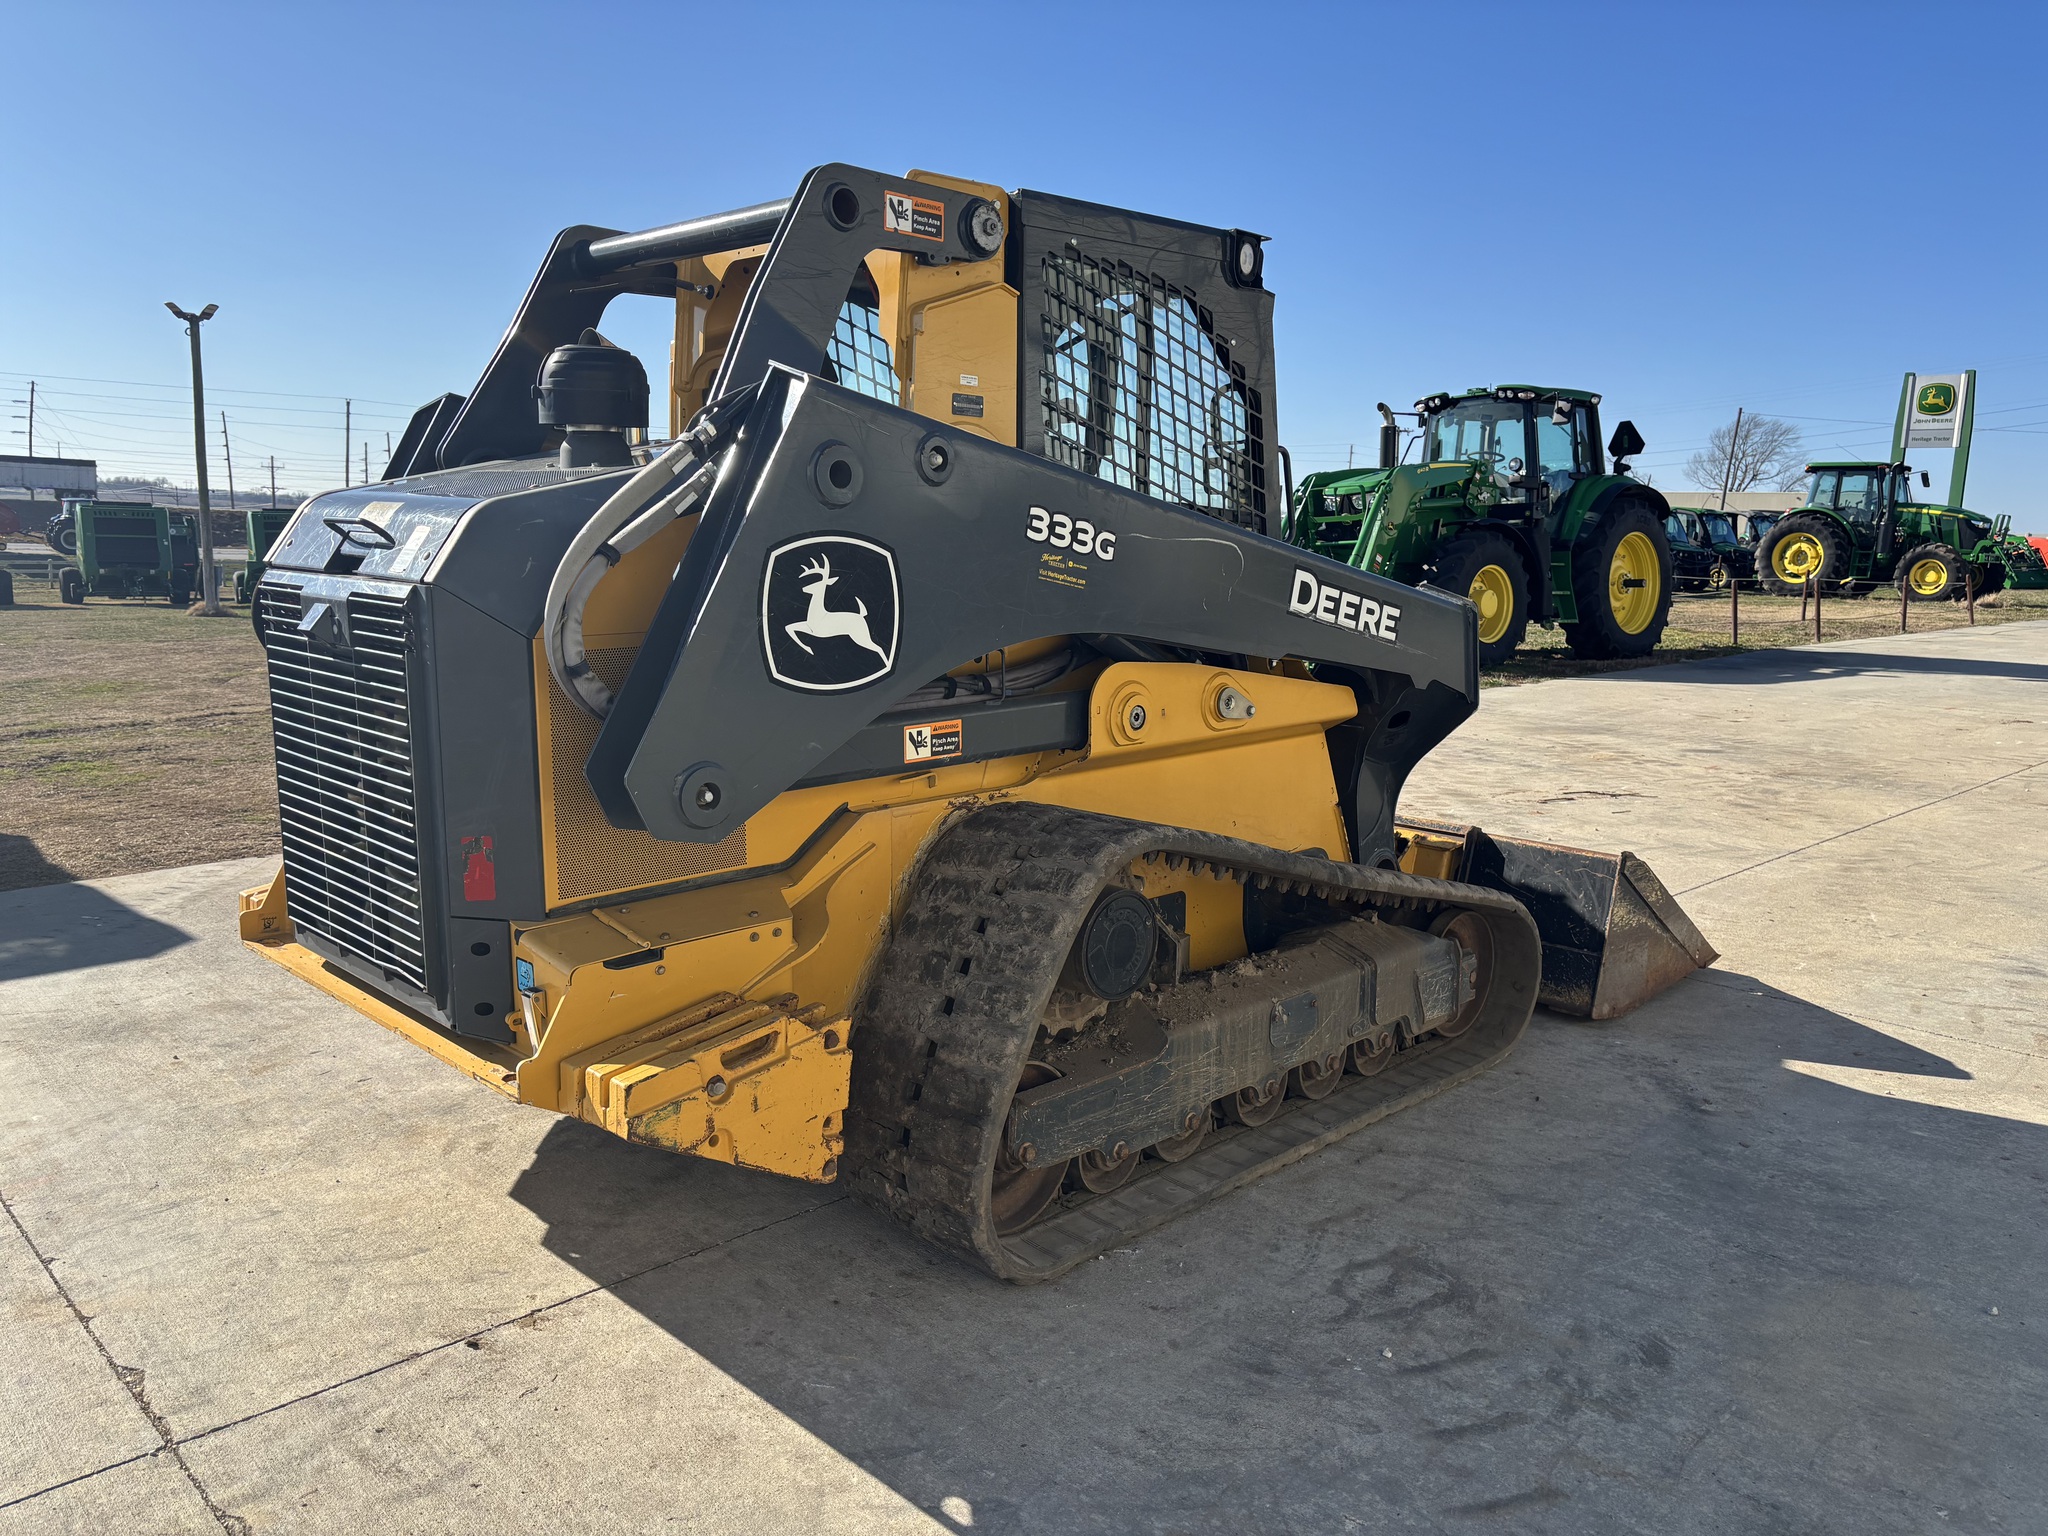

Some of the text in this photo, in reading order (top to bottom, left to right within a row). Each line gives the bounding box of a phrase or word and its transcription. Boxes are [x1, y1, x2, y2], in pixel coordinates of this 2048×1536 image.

[920, 202, 942, 212] WARNING
[913, 214, 941, 226] Pinch Area
[913, 223, 937, 234] Keep Away
[1026, 506, 1116, 561] 333G
[1289, 568, 1401, 641] DEERE
[937, 723, 959, 731] WARNING
[932, 737, 946, 745] Pinch
